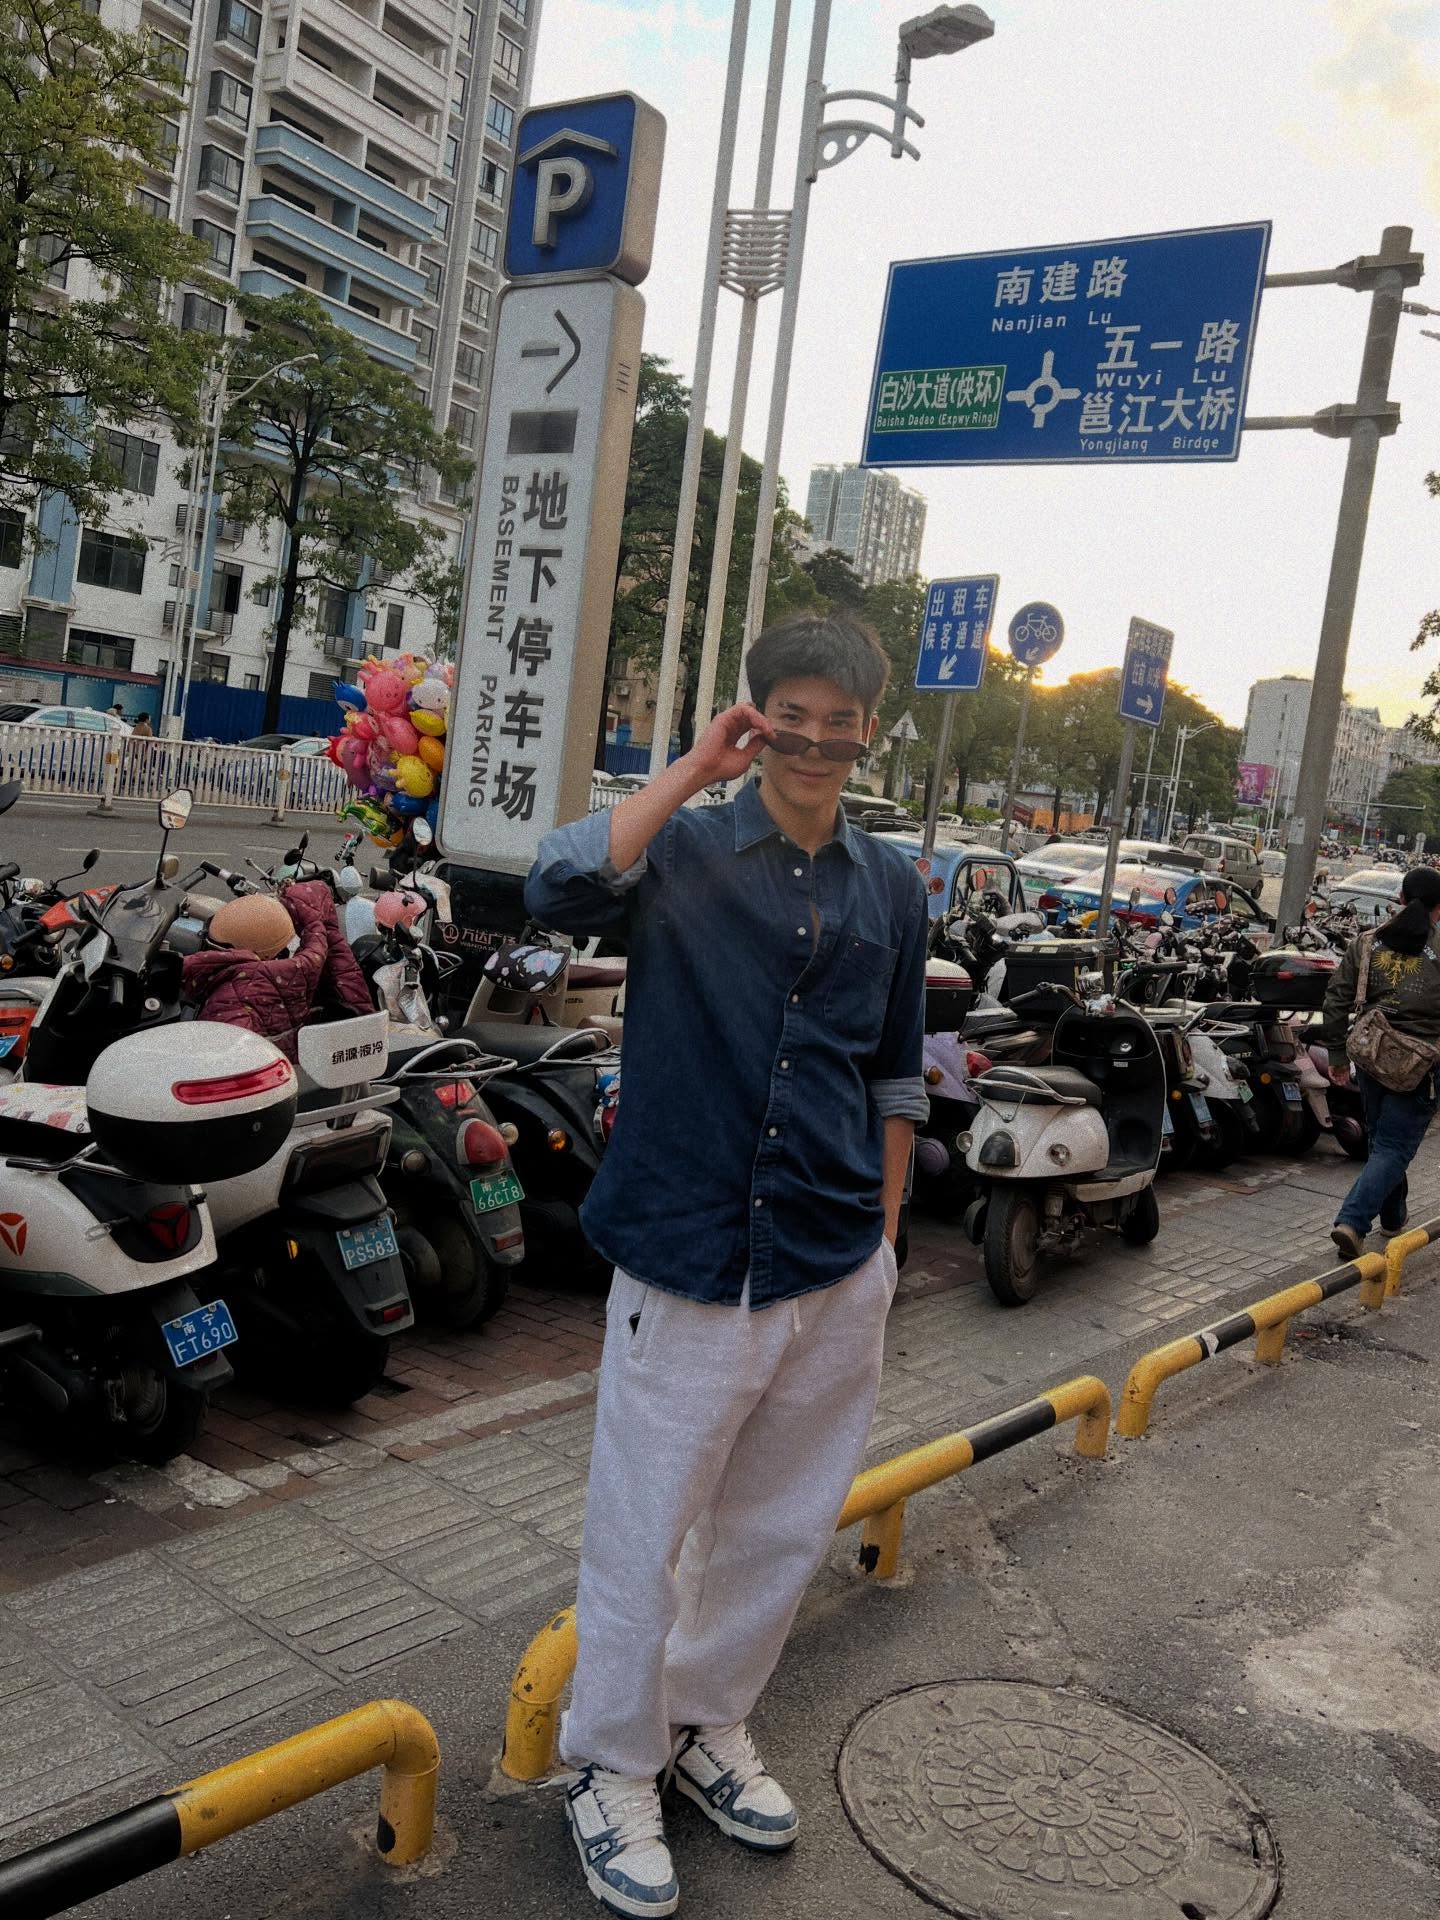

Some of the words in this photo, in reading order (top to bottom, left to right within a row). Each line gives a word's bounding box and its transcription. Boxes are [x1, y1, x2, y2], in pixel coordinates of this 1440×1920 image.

[532, 156, 592, 249] P
[994, 255, 1129, 308] 南建路
[991, 314, 1067, 334] Nanjian
[1088, 310, 1112, 325] Lu
[1096, 318, 1241, 370] 五一路
[879, 370, 1001, 413] 白沙大道(快环)
[1096, 369, 1163, 390] Wuyi
[1192, 368, 1227, 384] Lu
[876, 415, 905, 428] Baisha
[908, 414, 935, 426] Dadao
[938, 413, 970, 428] (Expwy
[971, 411, 997, 427] Ring)
[1078, 386, 1236, 435] 邕江大桥
[1080, 437, 1148, 455] Yongjiang
[1172, 436, 1220, 453] Birdge
[486, 474, 521, 645] BASEMENT
[930, 584, 990, 617] 出租车
[490, 470, 569, 823] 地下停车场
[924, 620, 985, 651] 候客通道
[467, 673, 498, 810] PARKING
[478, 1185, 520, 1210] 66CT8
[345, 1236, 394, 1266] PS583
[174, 1322, 232, 1362] FT690
[181, 1312, 214, 1337] 南宁
